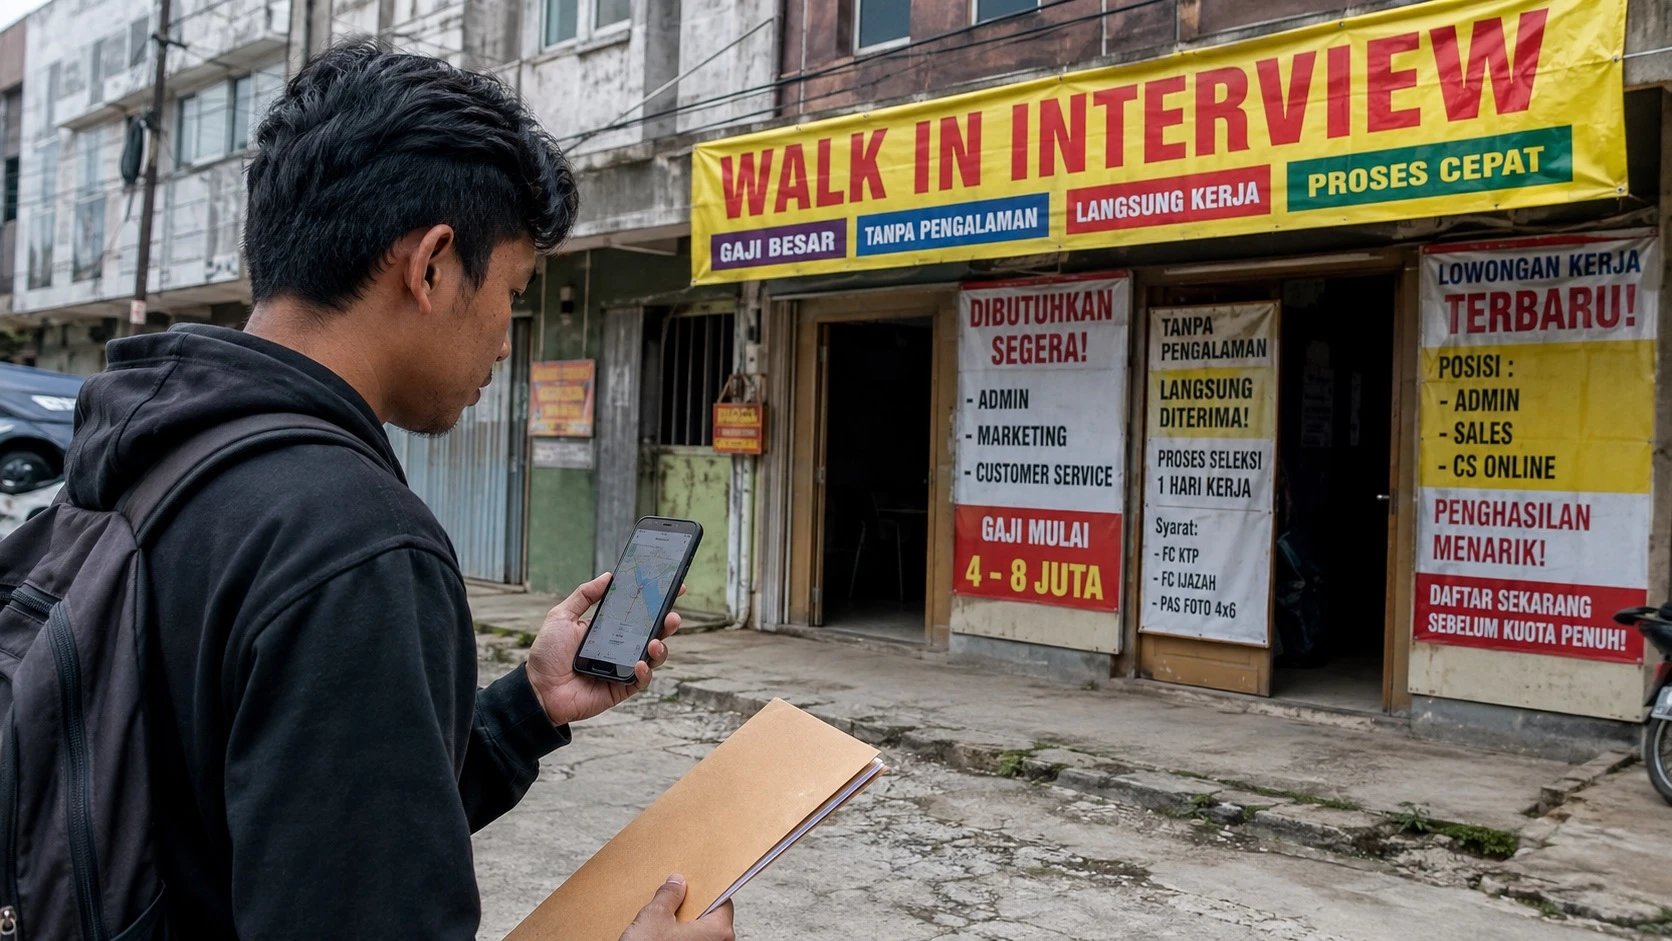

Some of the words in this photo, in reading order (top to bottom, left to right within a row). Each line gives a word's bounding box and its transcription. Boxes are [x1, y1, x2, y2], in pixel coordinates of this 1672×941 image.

[720, 128, 887, 219] WALK
[914, 111, 981, 194] IN
[1012, 8, 1549, 181] INTERVIEW
[1308, 161, 1427, 197] PROSES
[1440, 146, 1544, 183] CEPAT
[1076, 193, 1183, 223] LANGSUNG
[1192, 181, 1259, 210] KERJA
[865, 222, 915, 246] TANPA
[920, 208, 1037, 240] PENGALAMAN
[720, 240, 761, 262] GAJI
[769, 231, 834, 256] BESAR
[1439, 256, 1559, 285] LOWONGAN
[1569, 250, 1640, 277] KERJA
[970, 289, 1112, 327] DIBUTUHKAN
[1445, 284, 1636, 334] TERBARU!
[1162, 316, 1213, 336] TANPA
[992, 332, 1087, 365] SEGERA!
[1162, 339, 1266, 361] PENGALAMAN
[1439, 355, 1499, 379] POSISI
[978, 389, 1029, 409] ADMIN
[1160, 378, 1252, 400] LANGSUNG
[1454, 389, 1519, 411] ADMIN
[1160, 407, 1248, 427] DITERIMA!
[978, 426, 1066, 446] MARKETING
[1454, 421, 1512, 444] SALES
[1158, 450, 1205, 468] PROSES
[1210, 451, 1261, 470] SELEKSI
[1453, 454, 1476, 477] CS
[1484, 455, 1555, 479] ONLINE
[976, 462, 1049, 484] CUSTOMER
[1054, 465, 1112, 486] SERVICE
[1158, 476, 1163, 494] 1
[1170, 476, 1201, 495] HARI
[1207, 477, 1251, 498] KERJA
[1156, 517, 1198, 537] Syarat:
[1434, 499, 1590, 531] PENGHASILAN
[982, 516, 1022, 543] GAJI
[1028, 519, 1089, 548] MULAI
[1163, 546, 1175, 562] FC
[1179, 548, 1199, 563] KTP
[1433, 534, 1545, 566] MENARIK!
[965, 555, 981, 587] 4
[1011, 559, 1026, 592] 8
[1034, 561, 1103, 600] JUTA
[1162, 571, 1174, 587] FC
[1178, 573, 1216, 591] IJAZAH
[1161, 596, 1180, 612] PAS
[1184, 598, 1211, 616] FOTO
[1215, 602, 1236, 618] 4x6
[1430, 584, 1492, 610] DAFTAR
[1498, 590, 1591, 618] SEKARANG
[1428, 613, 1498, 639] SEBELUM
[1503, 619, 1556, 644] KUOTA
[1561, 626, 1626, 651] PENUH!
